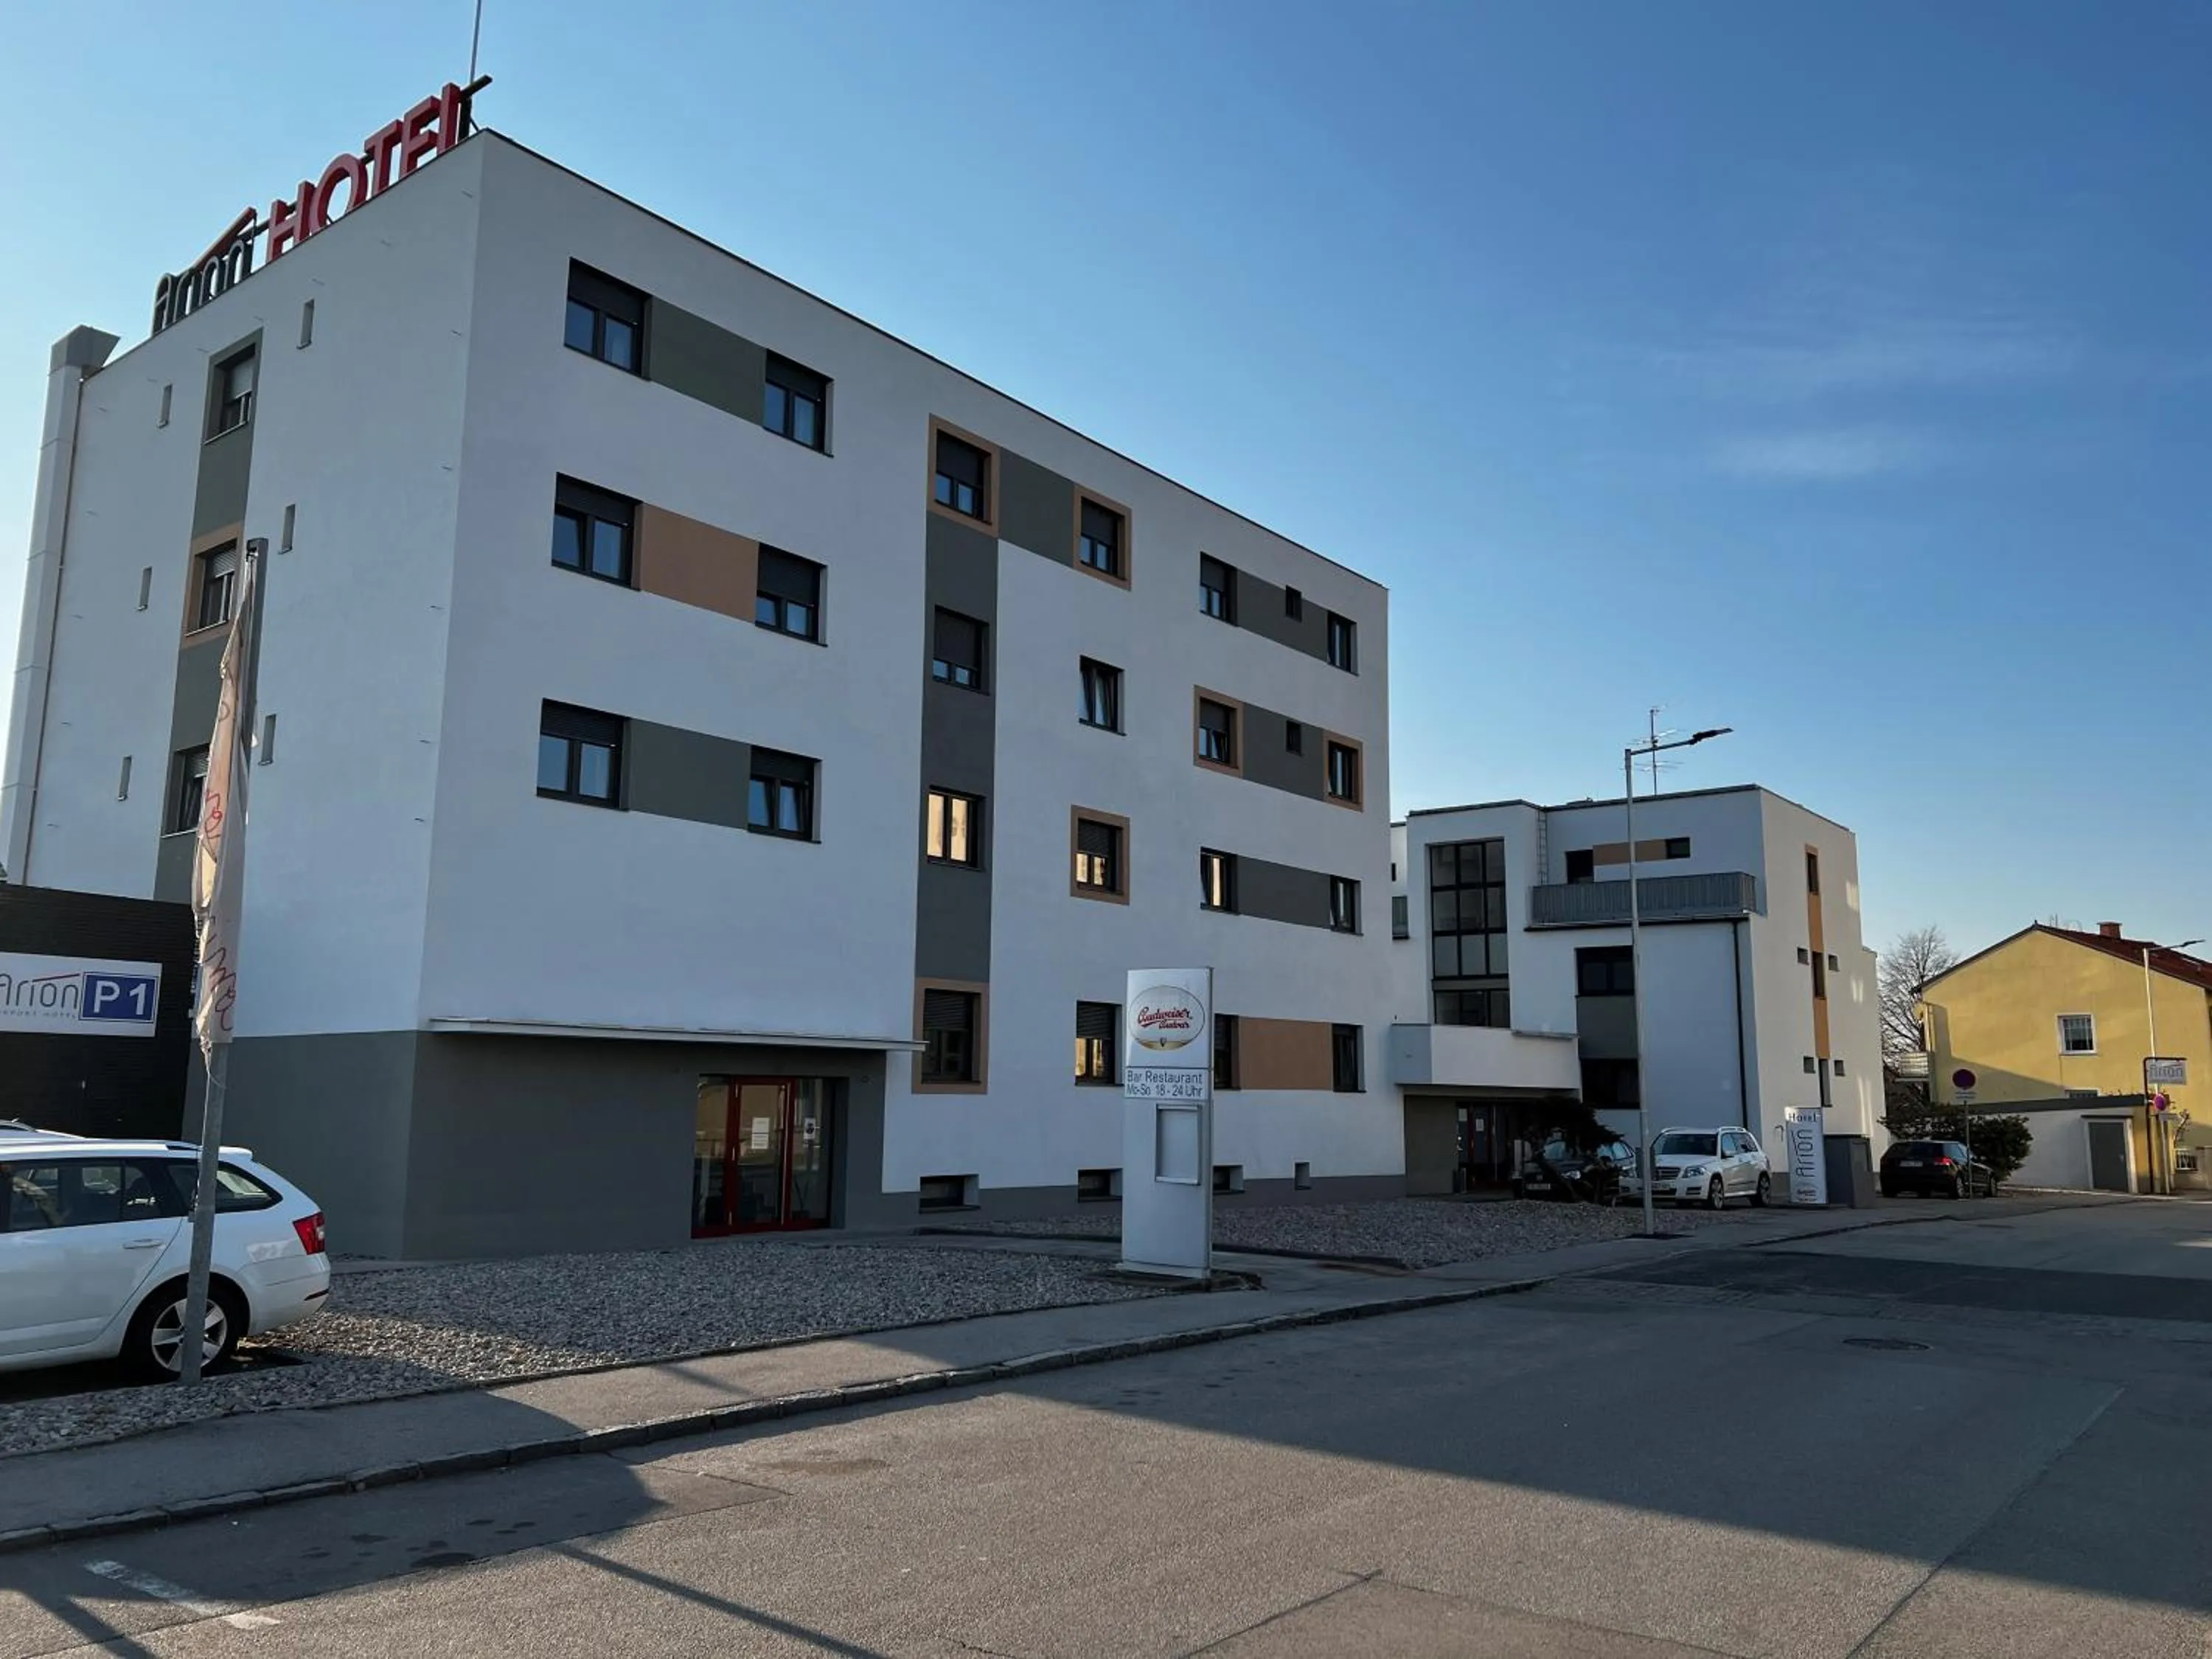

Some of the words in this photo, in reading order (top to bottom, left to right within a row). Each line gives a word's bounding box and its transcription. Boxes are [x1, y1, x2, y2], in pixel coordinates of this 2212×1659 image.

[1127, 1070, 1142, 1082] Bar
[1145, 1070, 1203, 1084] Restaurant
[1185, 1085, 1203, 1097] Uhr
